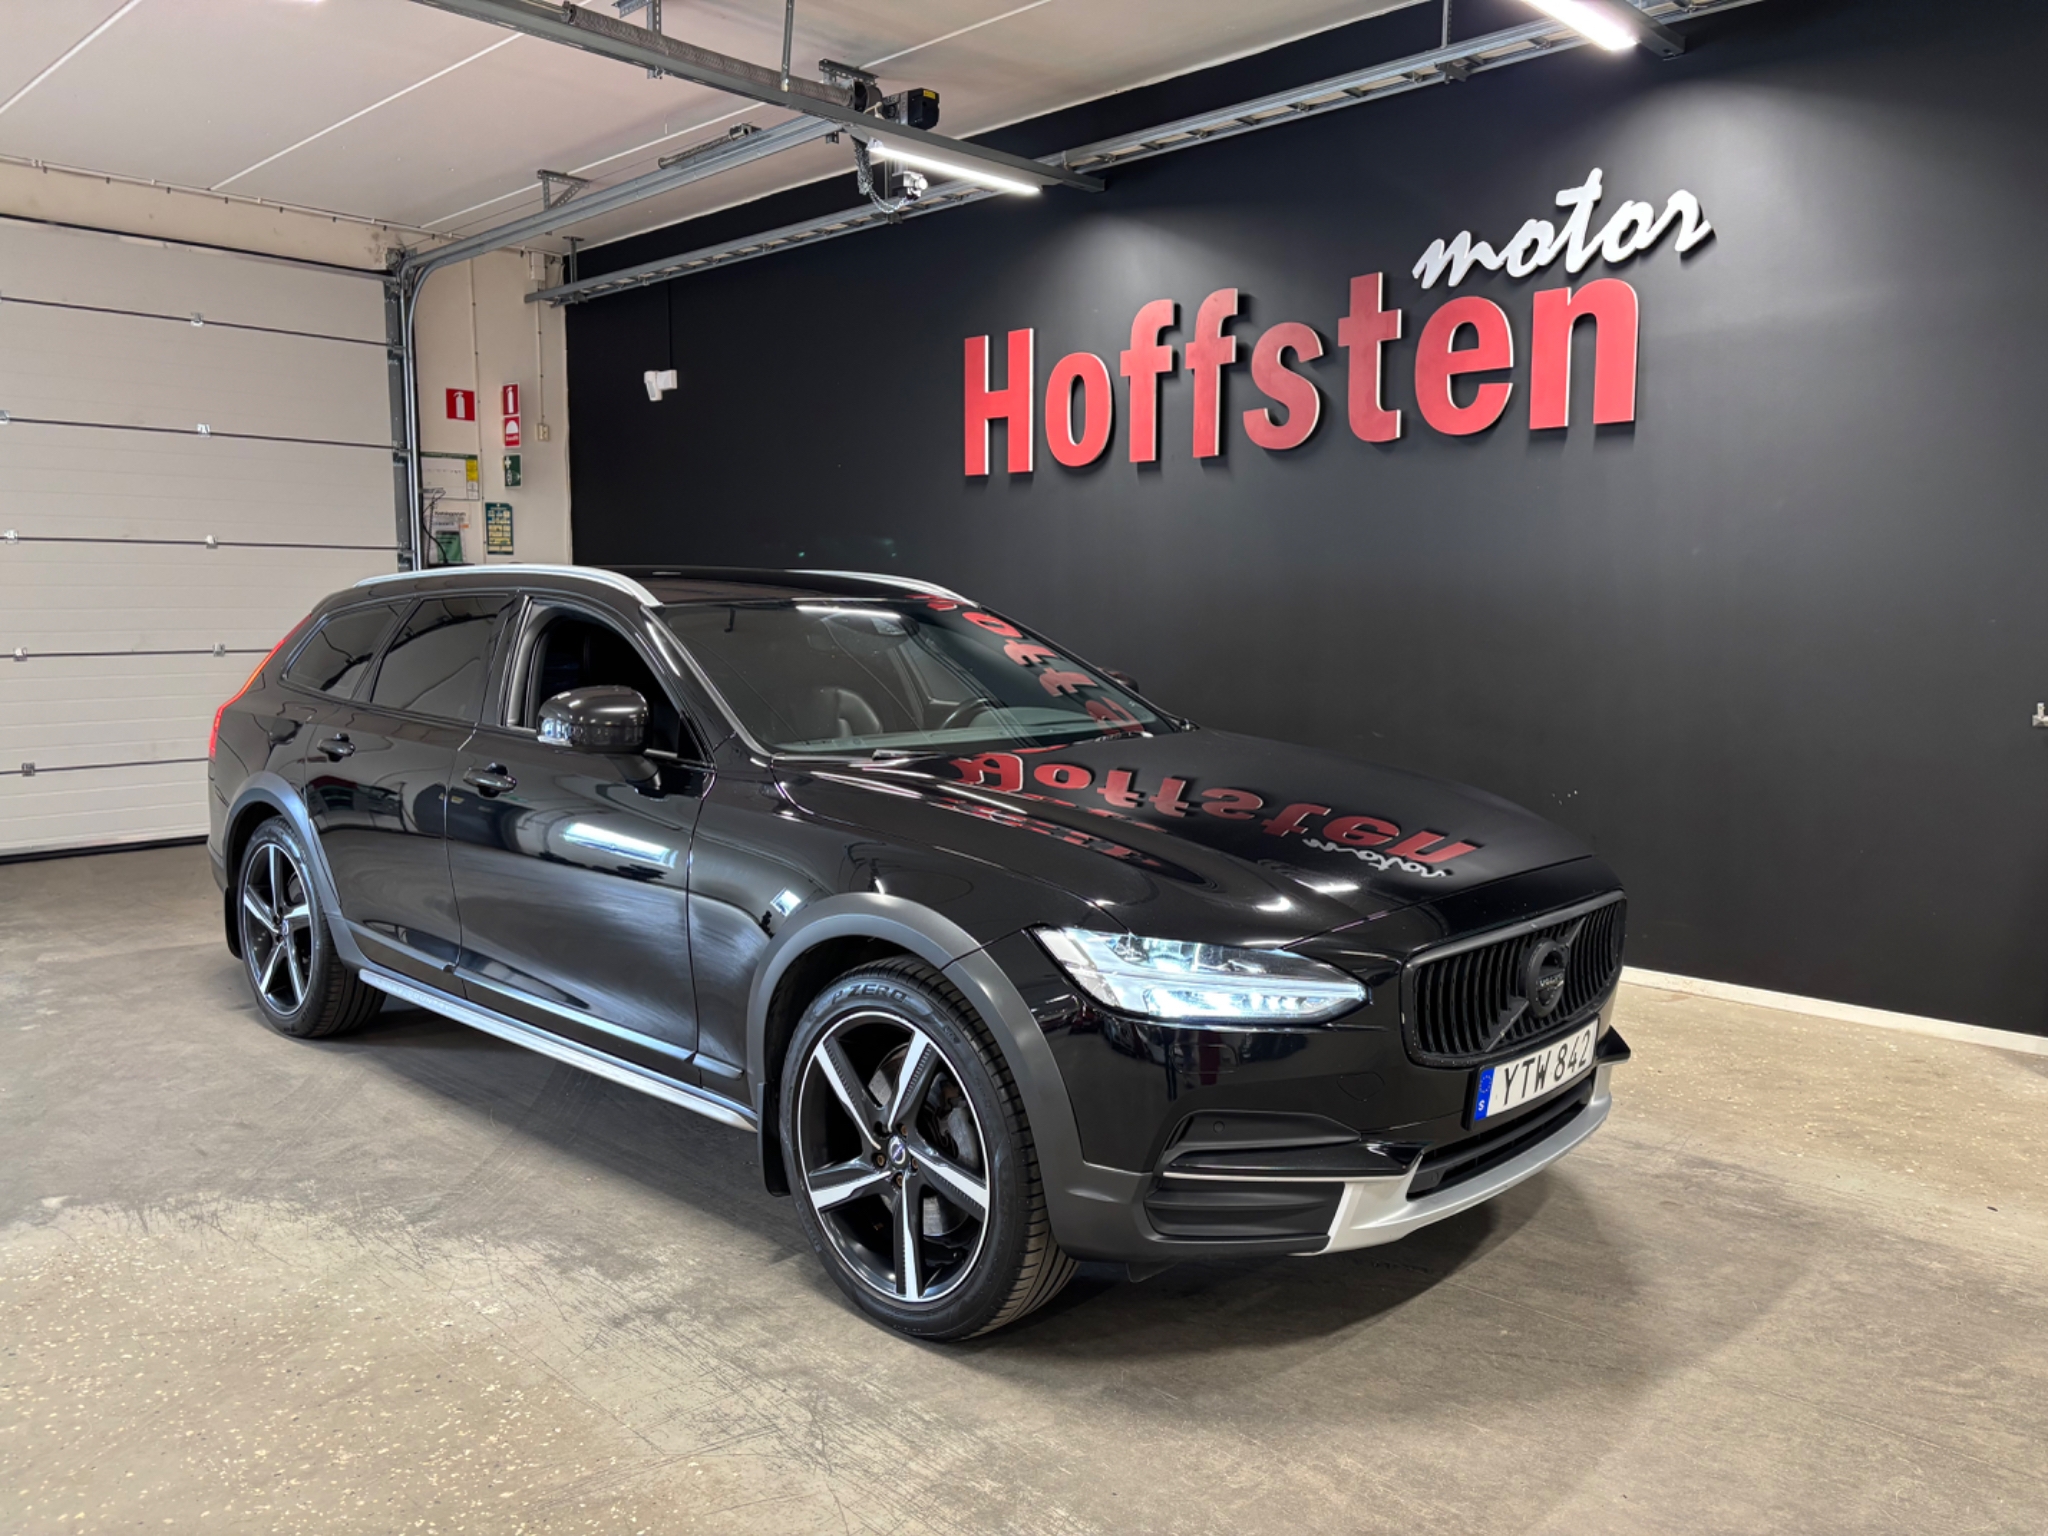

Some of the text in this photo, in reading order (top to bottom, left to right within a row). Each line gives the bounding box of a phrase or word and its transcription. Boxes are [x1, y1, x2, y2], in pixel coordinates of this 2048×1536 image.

[1413, 167, 1711, 289] motor
[964, 273, 1640, 476] Hoffsten
[832, 983, 908, 1005] P ZERO
[1478, 1099, 1486, 1111] S
[1503, 1029, 1591, 1107] YTW 842
